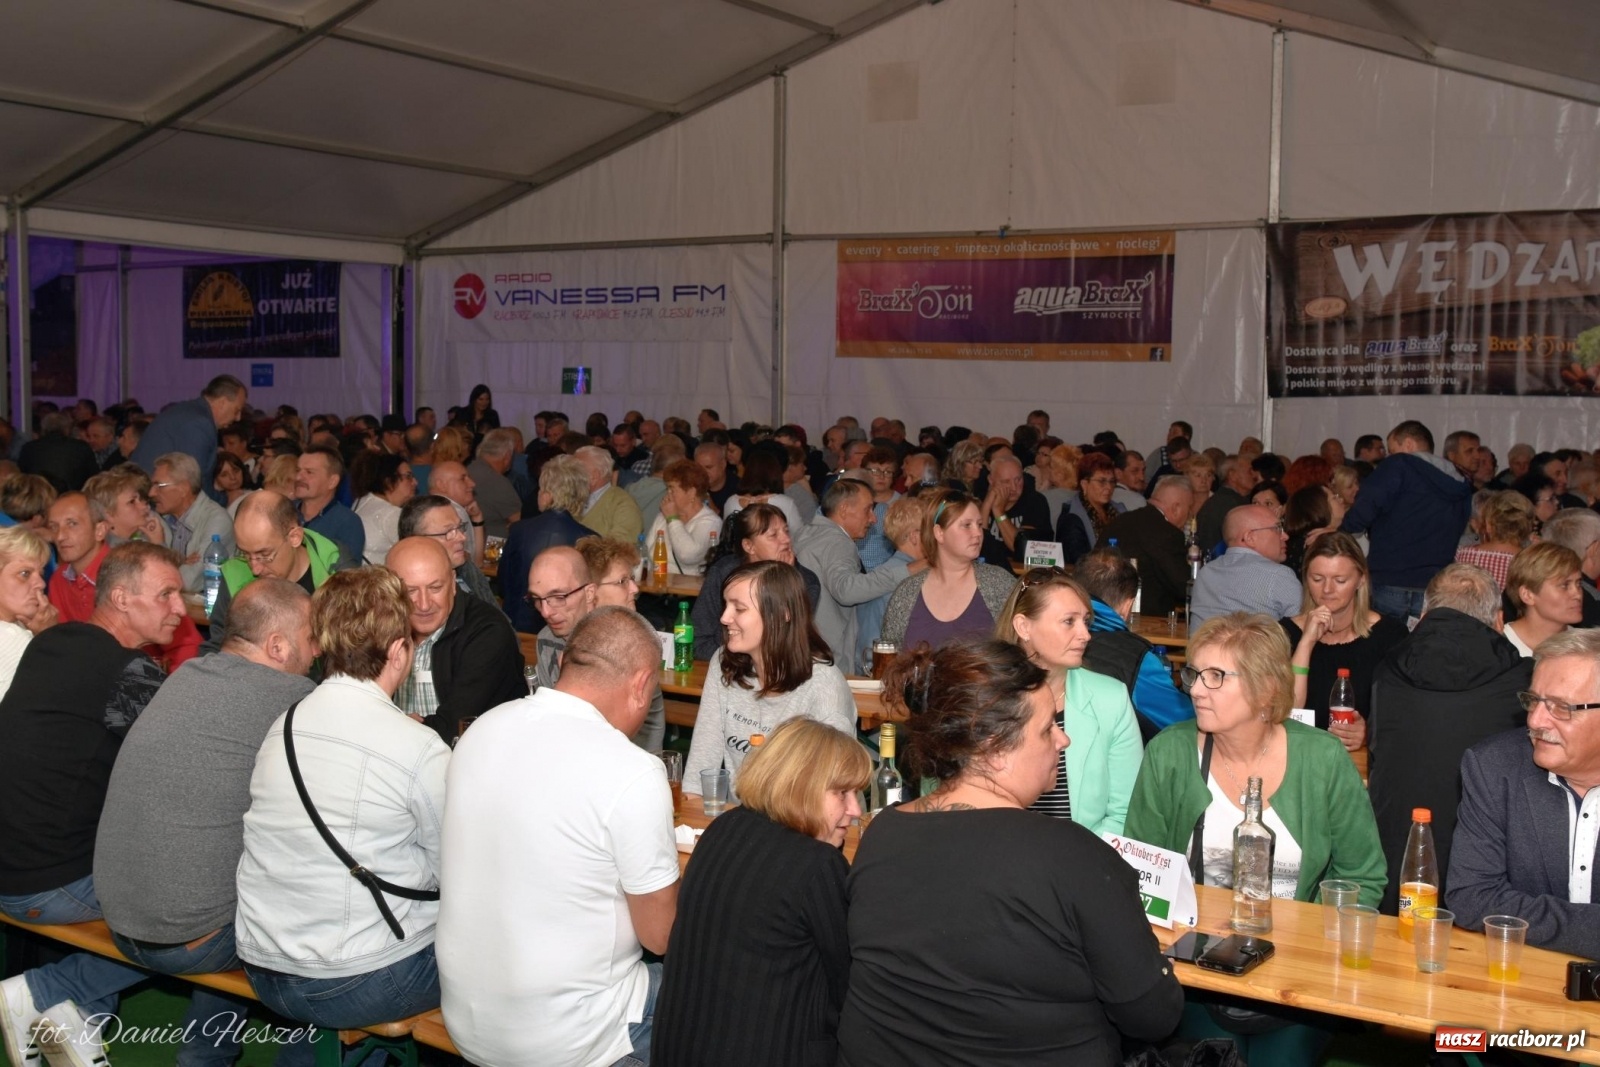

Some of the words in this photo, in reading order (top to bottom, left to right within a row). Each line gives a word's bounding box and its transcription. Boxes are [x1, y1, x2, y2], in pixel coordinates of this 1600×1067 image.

[846, 246, 882, 257] eventy
[896, 243, 940, 256] catering
[955, 242, 1001, 255] imprezy
[1004, 239, 1100, 252] okolicznościowe
[1116, 237, 1160, 251] noclegi
[281, 268, 313, 289] JUŻ
[494, 273, 552, 284] RADIO
[494, 286, 660, 306] VANESSA
[672, 284, 726, 302] FM
[257, 297, 337, 316] OTWARTE
[956, 346, 1034, 358] www.braxton.pl
[1285, 346, 1338, 357] Dostawca
[1341, 344, 1360, 355] dla
[1451, 342, 1478, 352] oraz
[1285, 365, 1348, 376] Dostarczamy
[1350, 362, 1388, 375] wędliny
[1399, 361, 1435, 373] własnej
[1436, 361, 1486, 372] wędzarni
[563, 373, 590, 381] STREA
[1290, 377, 1325, 388] polskie
[1327, 378, 1357, 389] mięso
[1367, 376, 1414, 388] własnego
